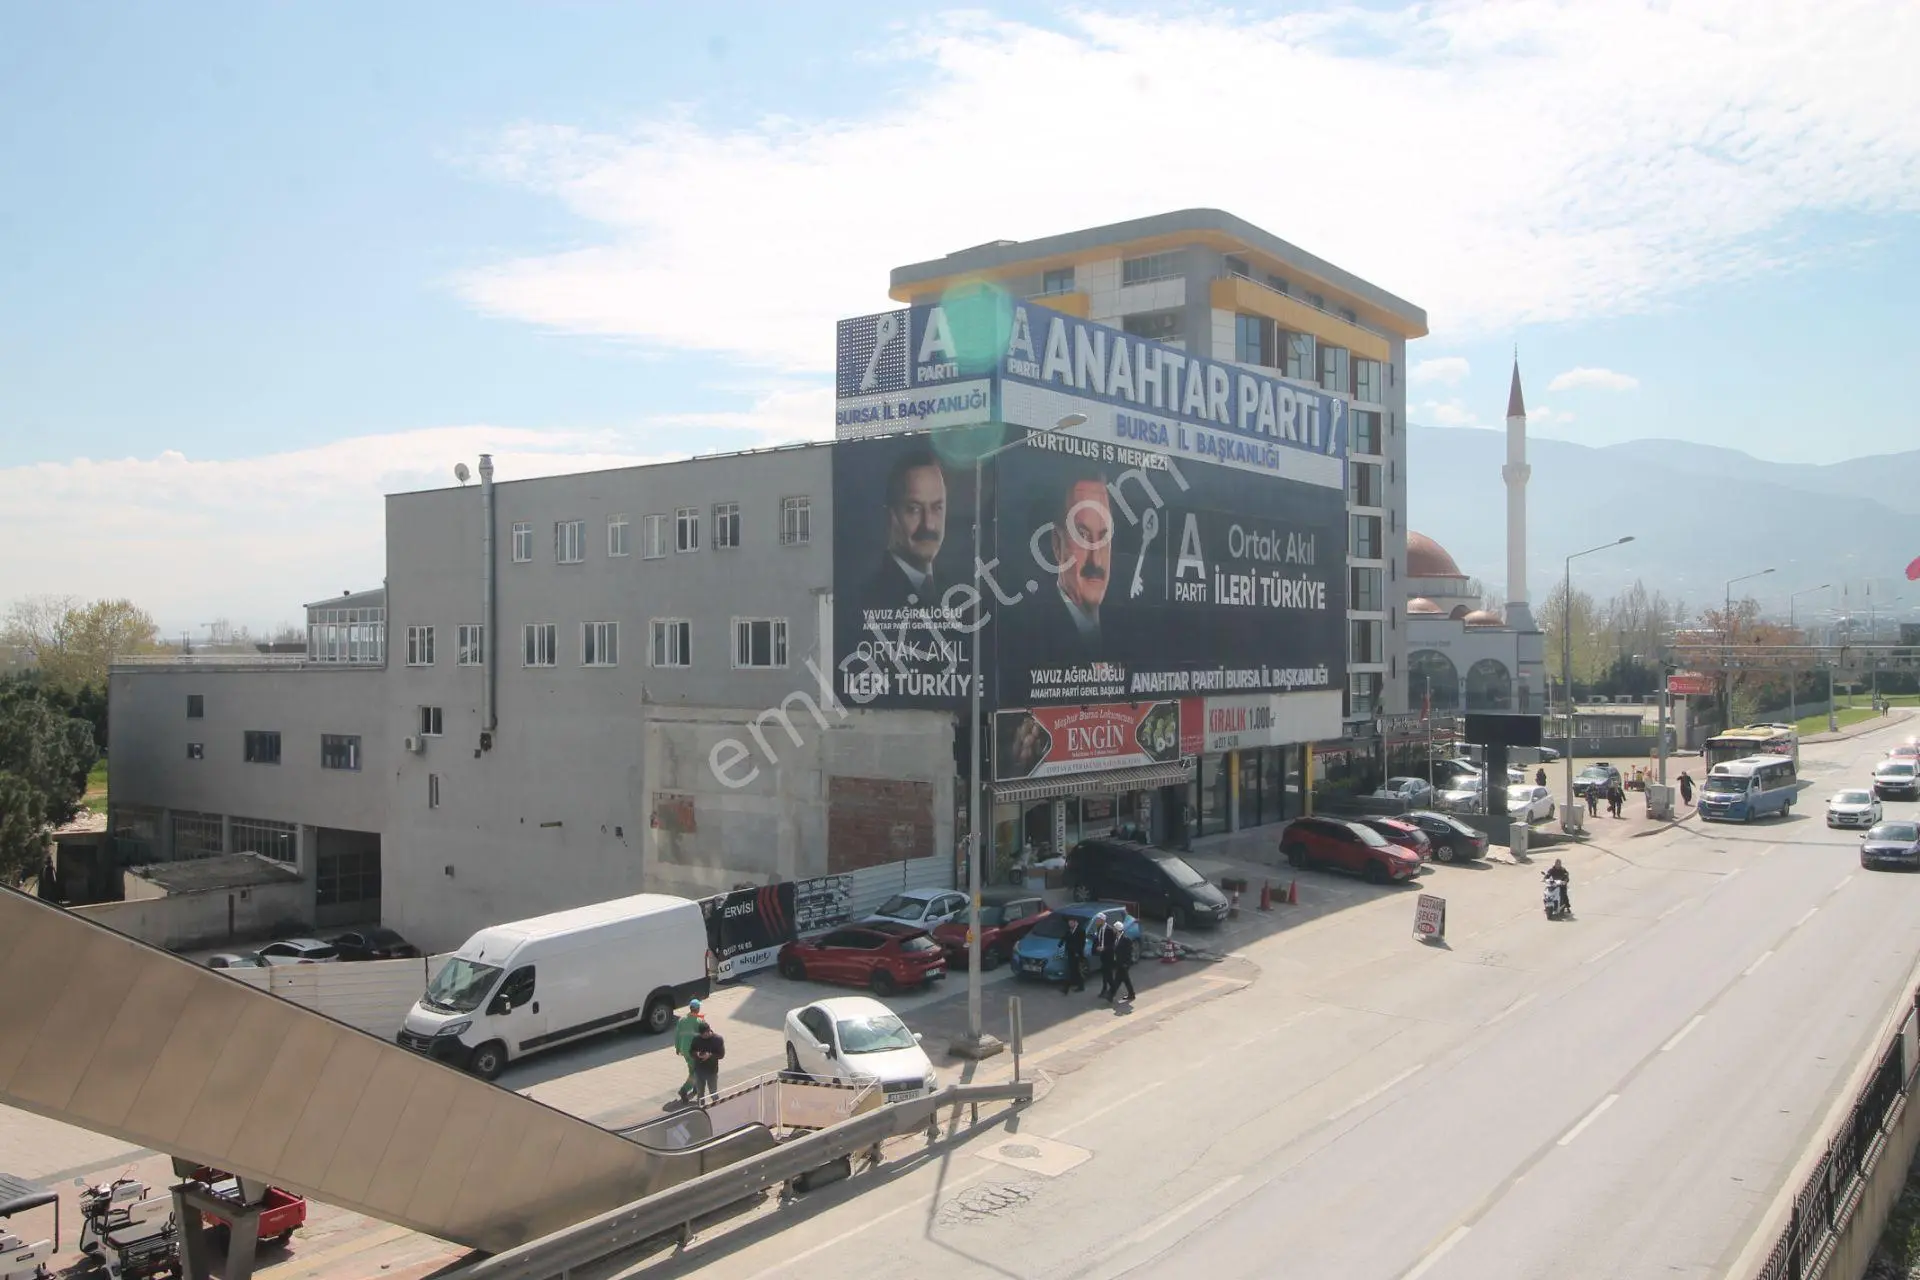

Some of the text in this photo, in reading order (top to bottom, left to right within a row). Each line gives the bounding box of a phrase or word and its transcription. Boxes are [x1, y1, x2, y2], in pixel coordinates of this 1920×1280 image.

[918, 307, 957, 362] A
[1041, 317, 1230, 424] ANAHTAR
[837, 406, 878, 425] BURSA
[1116, 413, 1169, 447] BURSA
[1026, 429, 1100, 462] KURTULUŞ
[1175, 512, 1206, 580] A
[1228, 524, 1315, 566] Ortak Akıl
[1215, 565, 1326, 610] İLERİ TÜRKİYE
[863, 608, 893, 620] YAVUZ
[857, 640, 969, 662] ORTAK AKIL
[843, 667, 890, 695] İLERİ
[1030, 669, 1062, 684] YAVUZ
[1030, 688, 1061, 699] ANAHTAR
[1080, 686, 1099, 697] GENEL
[1130, 671, 1190, 693] ANAHTAR
[1225, 669, 1261, 689] BURSA
[1067, 720, 1124, 752] ENGİN
